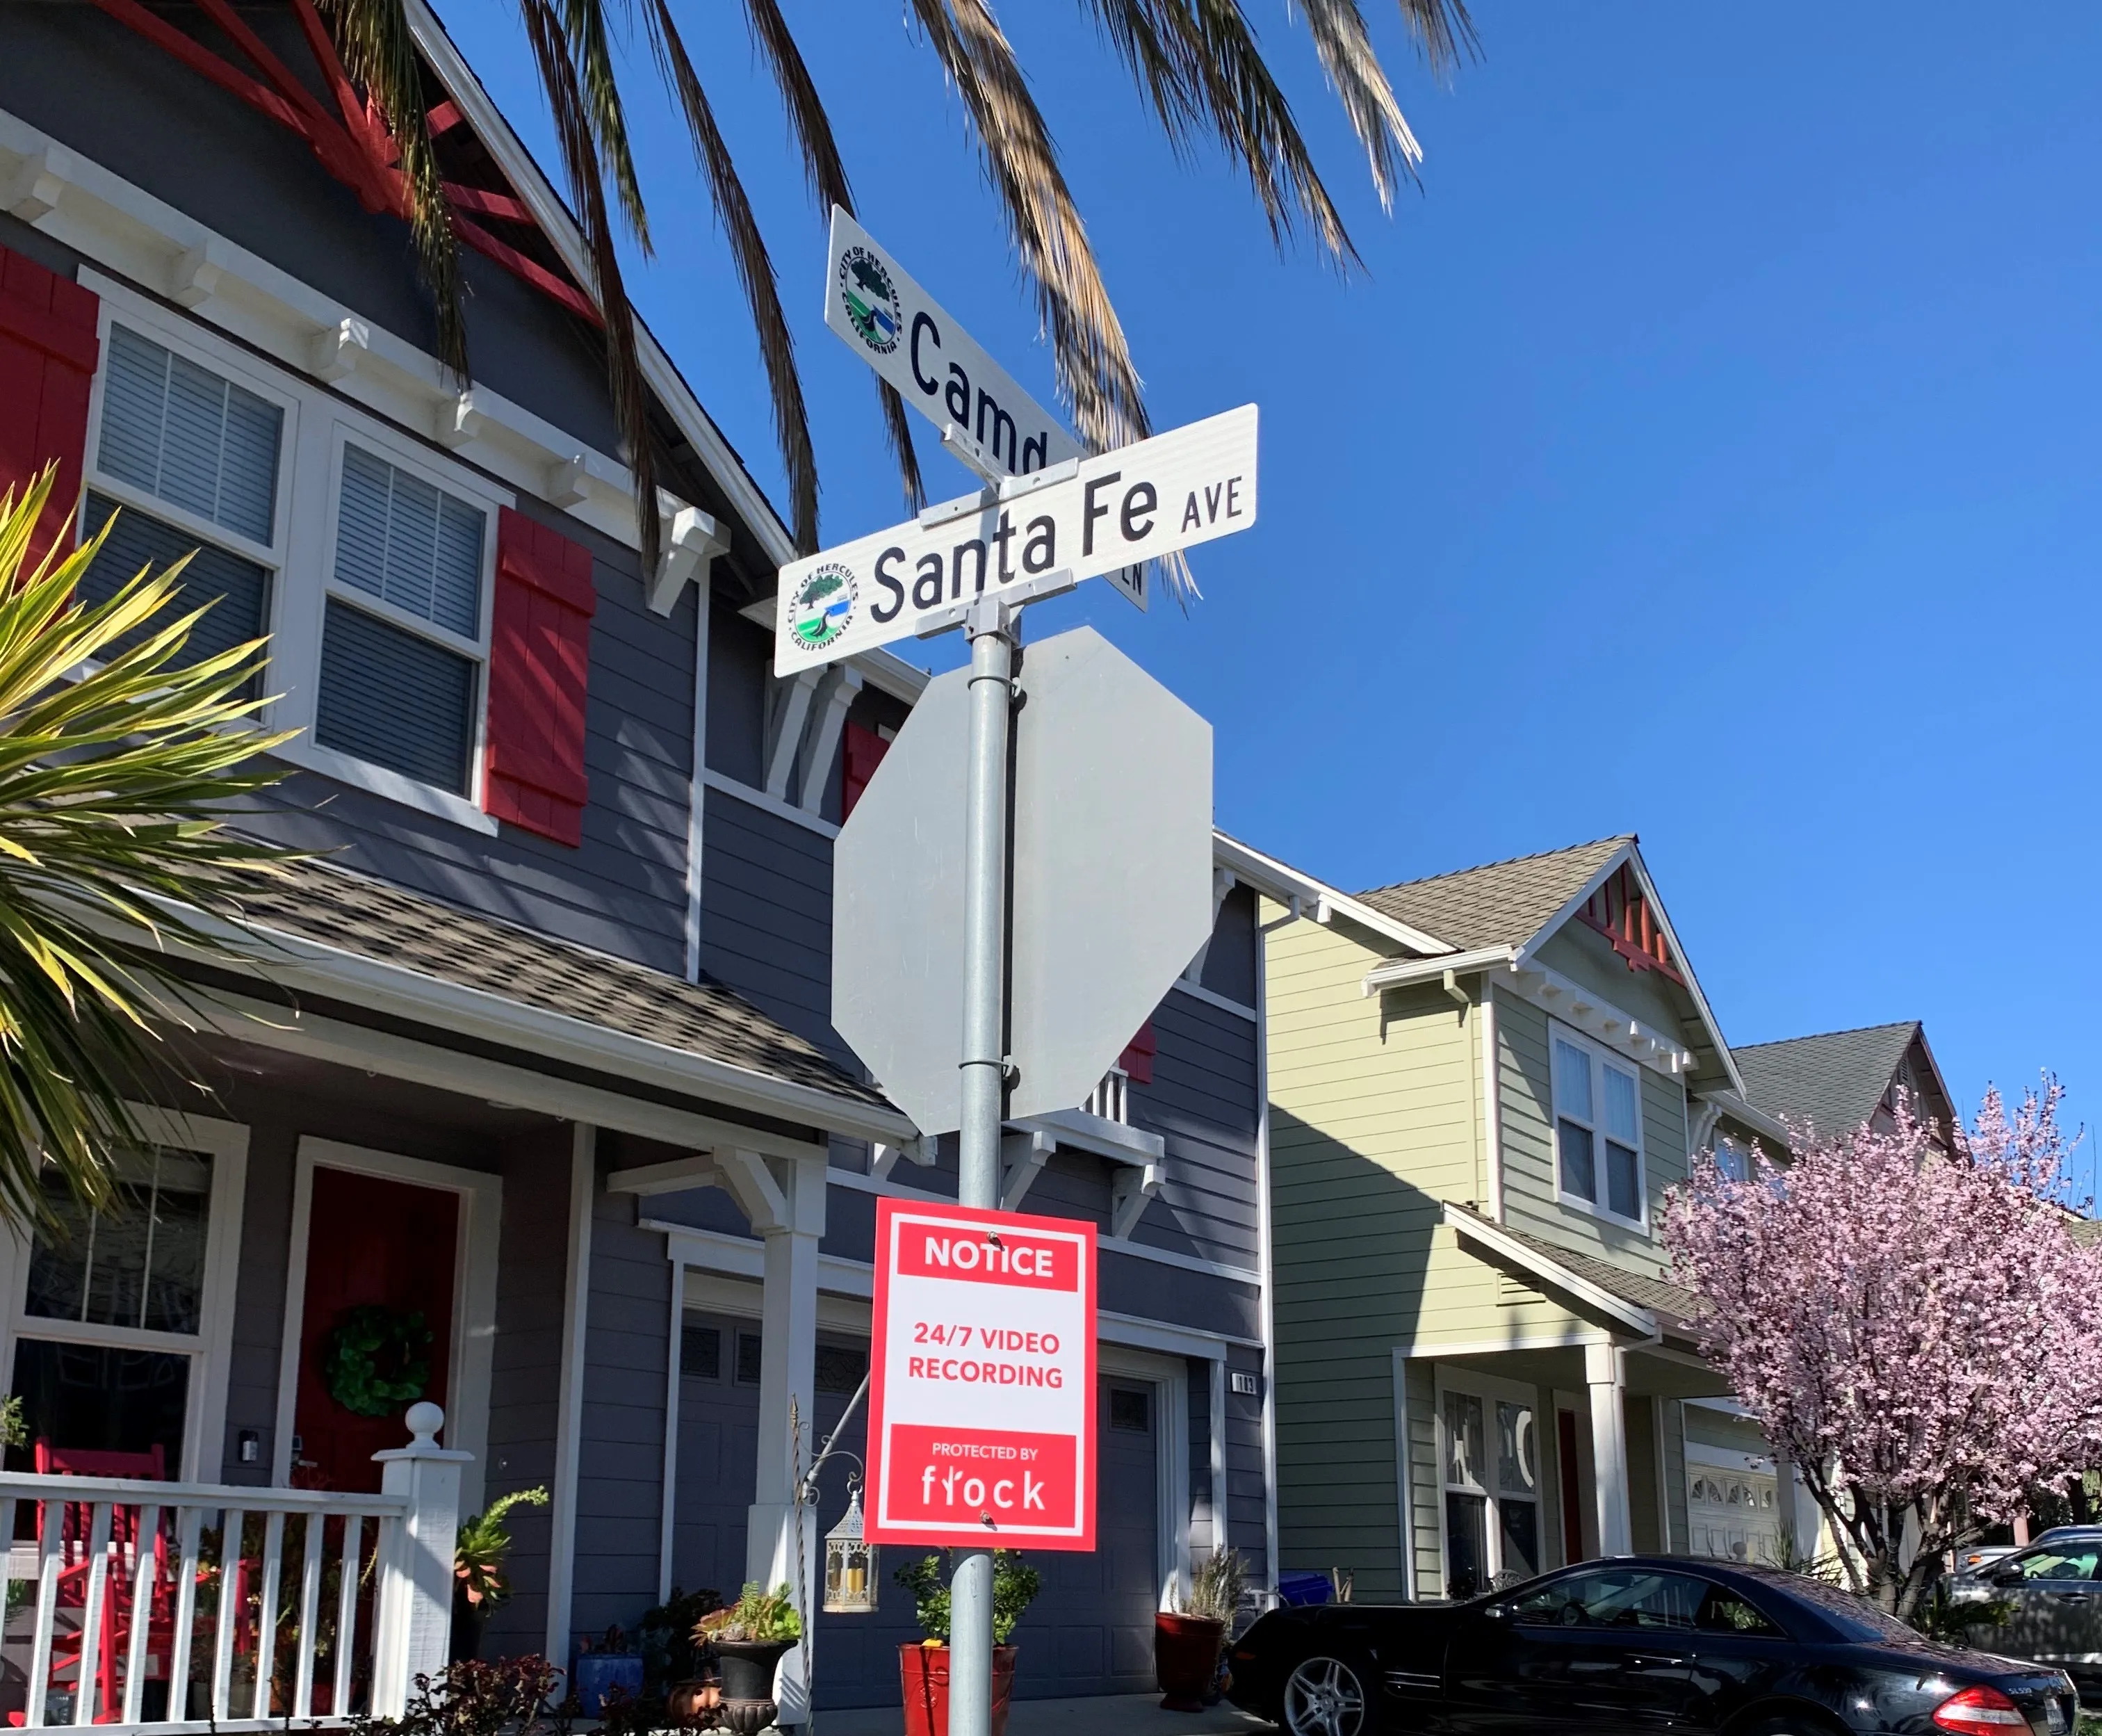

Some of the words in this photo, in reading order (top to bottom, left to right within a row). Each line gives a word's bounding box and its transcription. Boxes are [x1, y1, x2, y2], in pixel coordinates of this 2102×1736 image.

[839, 250, 851, 279] CITY
[852, 246, 865, 256] OF
[867, 251, 902, 334] HERCULES
[842, 292, 898, 355] CALIFORNIA
[870, 508, 1055, 623] Santa
[1082, 471, 1157, 557] Fe
[1181, 476, 1242, 533] AVE
[788, 591, 799, 624] CITY
[800, 572, 813, 588] OF
[817, 563, 858, 601] HERCULES
[1121, 562, 1142, 596] LN
[791, 615, 853, 651] CALIFORNIA
[924, 1236, 1053, 1278] NOTICE
[913, 1322, 972, 1347] 24/7
[980, 1328, 1059, 1354] VIDEO
[909, 1356, 1062, 1388] RECORDING
[932, 1443, 1017, 1460] PROTECTED
[1020, 1447, 1038, 1461] BY
[922, 1465, 1045, 1510] flock
